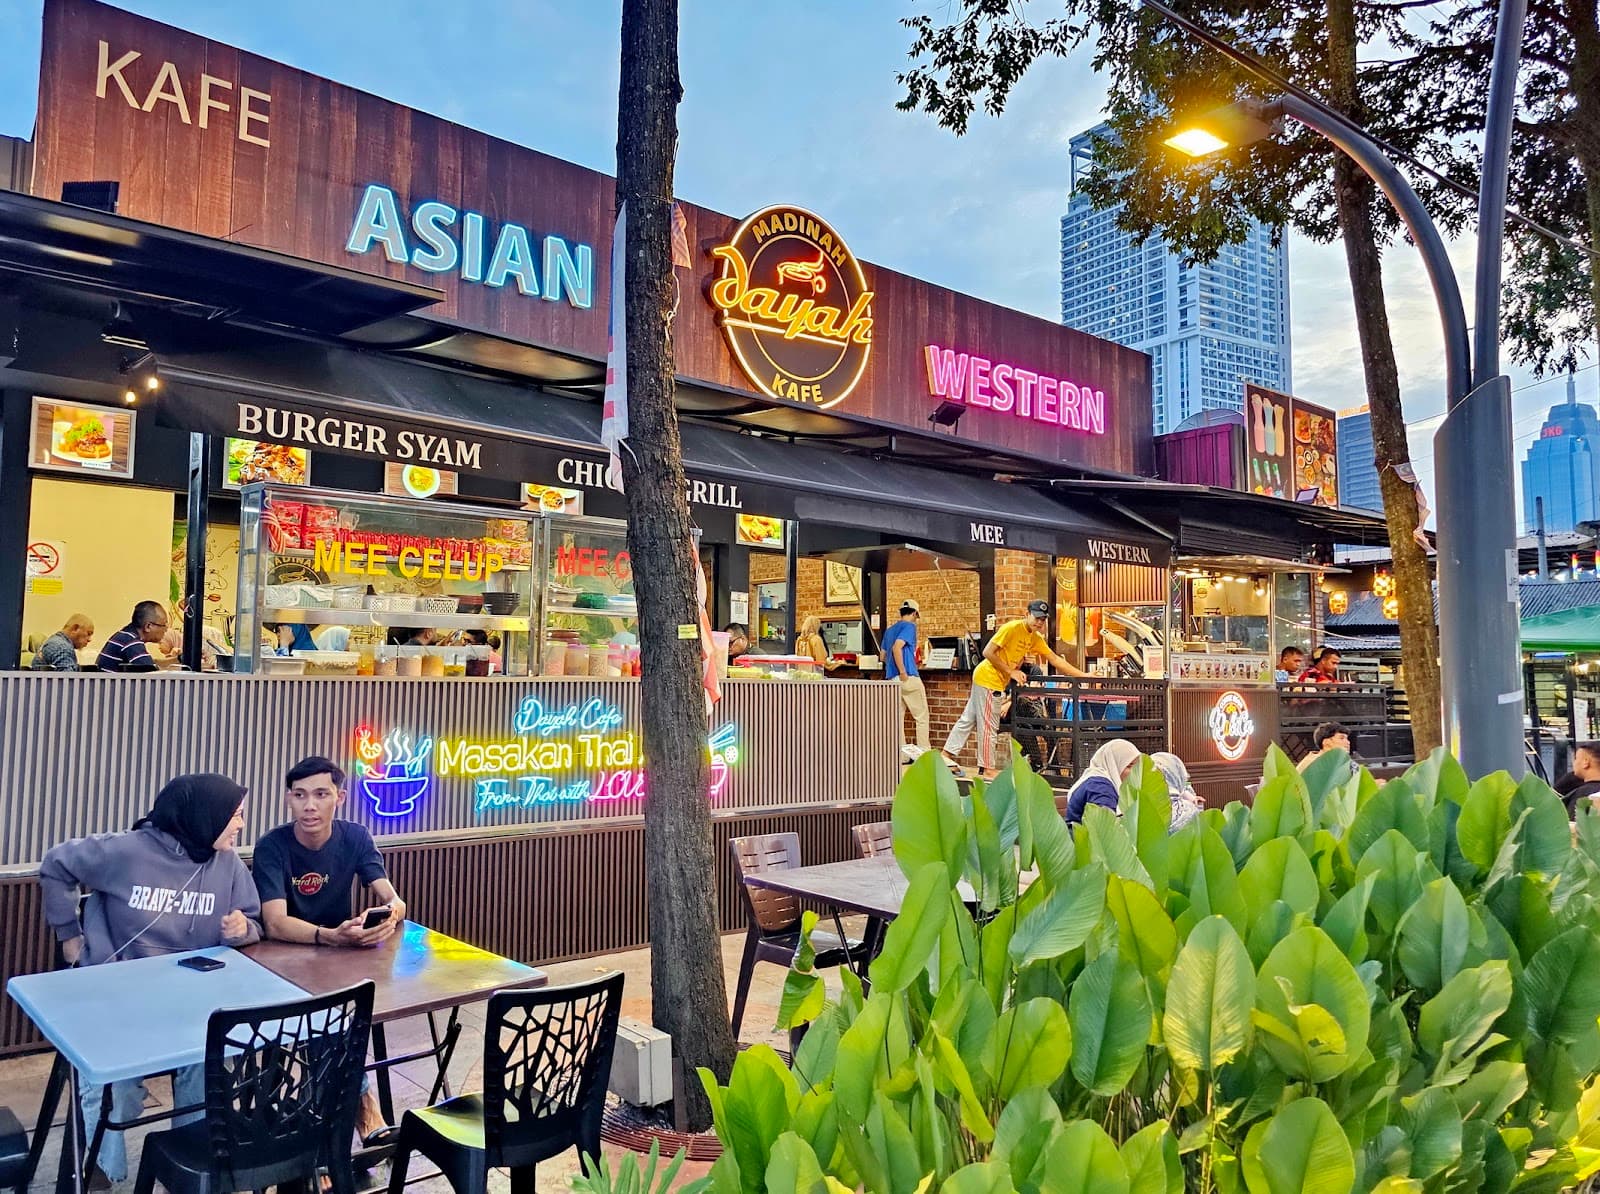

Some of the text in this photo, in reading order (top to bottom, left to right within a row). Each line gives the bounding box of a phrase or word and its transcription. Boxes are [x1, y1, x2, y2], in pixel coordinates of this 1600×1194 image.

[96, 40, 272, 148] KAFE
[345, 184, 593, 310] ASIAN
[752, 213, 847, 268] MADINAH
[712, 245, 875, 344] dayah
[771, 373, 824, 403] KAFE
[924, 345, 1105, 435] WESTERN
[237, 402, 483, 470] BURGER SYAM
[970, 522, 1004, 545] MEE
[1087, 539, 1151, 564] WESTERN
[314, 538, 504, 583] MEE CELUP
[557, 546, 609, 577] MEE
[516, 698, 624, 737] Dayah Cafe
[438, 736, 574, 776] Masakan
[578, 732, 635, 768] Thai
[478, 778, 521, 810] From
[128, 885, 216, 916] BRAVE-MIND
[291, 873, 330, 888] Hard Rock
